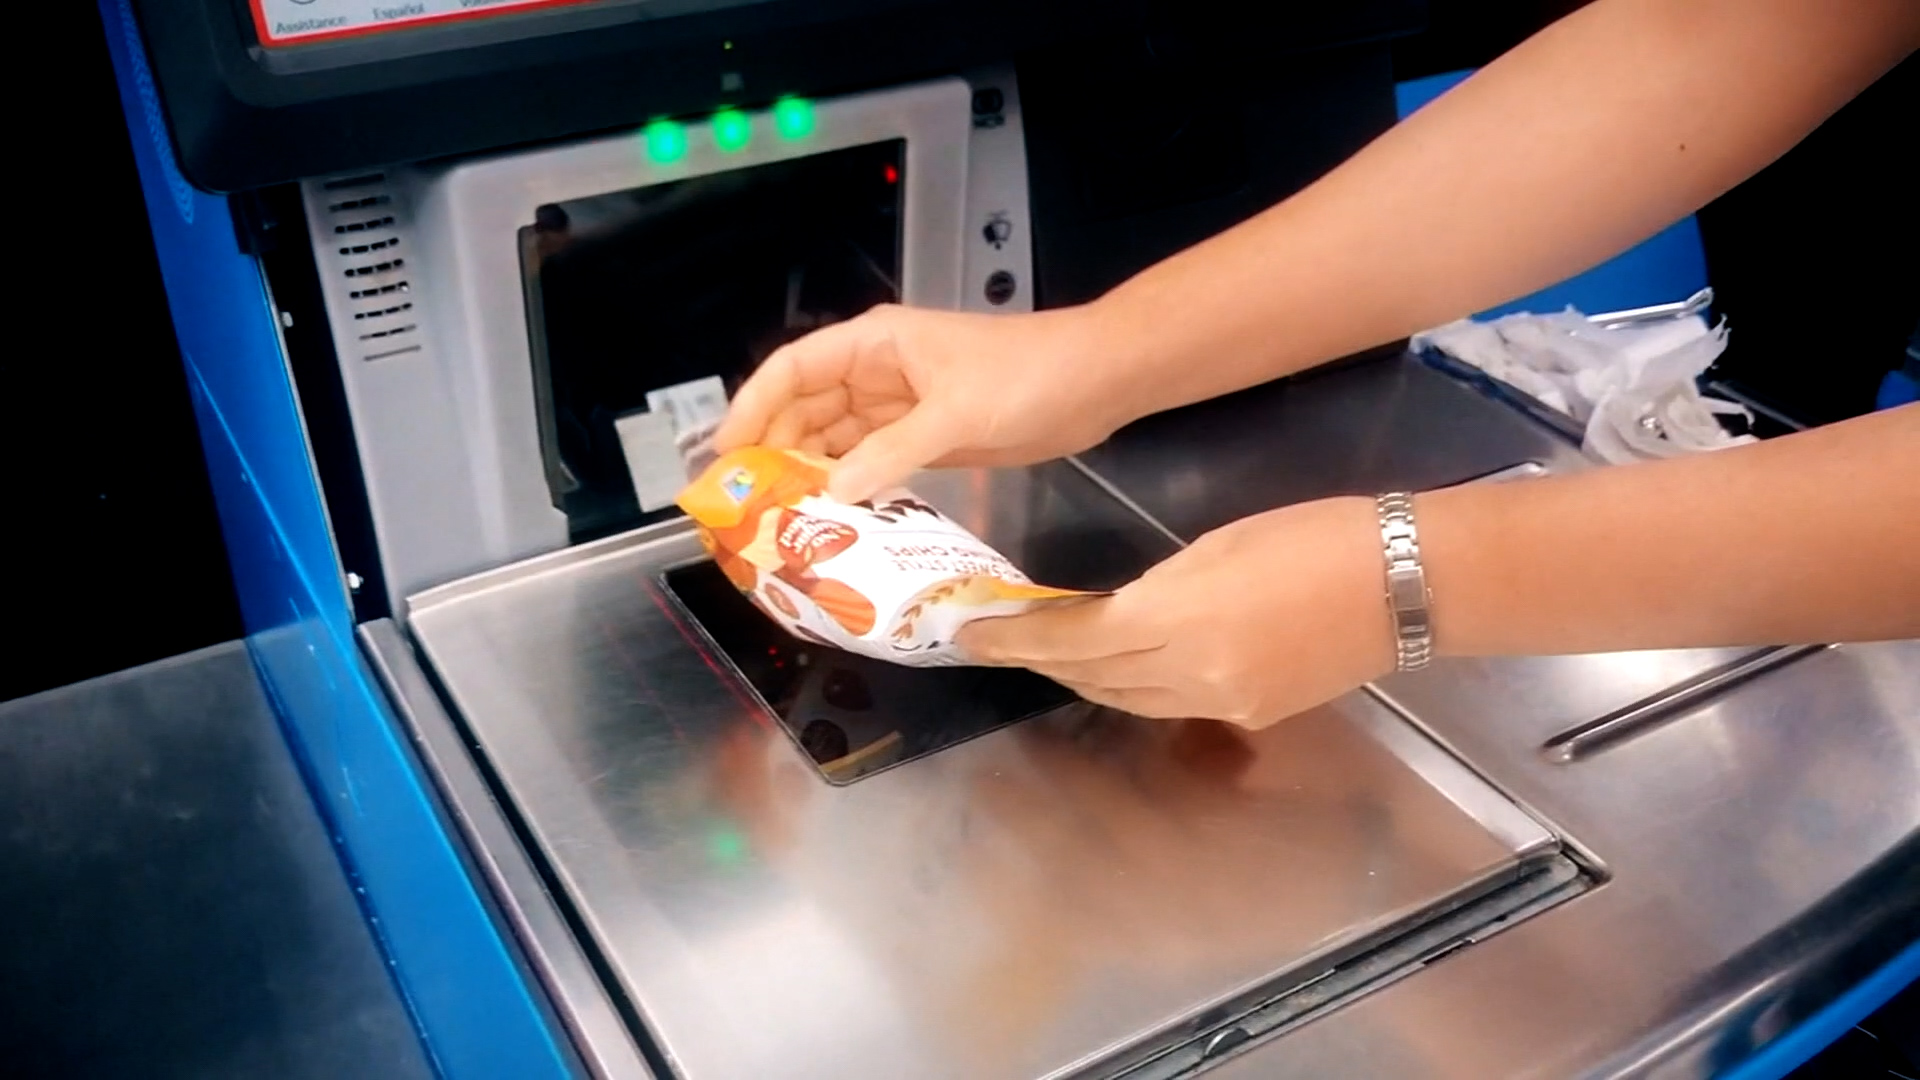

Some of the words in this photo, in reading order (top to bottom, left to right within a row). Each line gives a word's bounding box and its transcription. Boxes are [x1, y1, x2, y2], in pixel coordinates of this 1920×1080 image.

[275, 16, 347, 35] Assistance
[884, 545, 949, 557] CHIPS
[891, 559, 948, 572] STYLE
